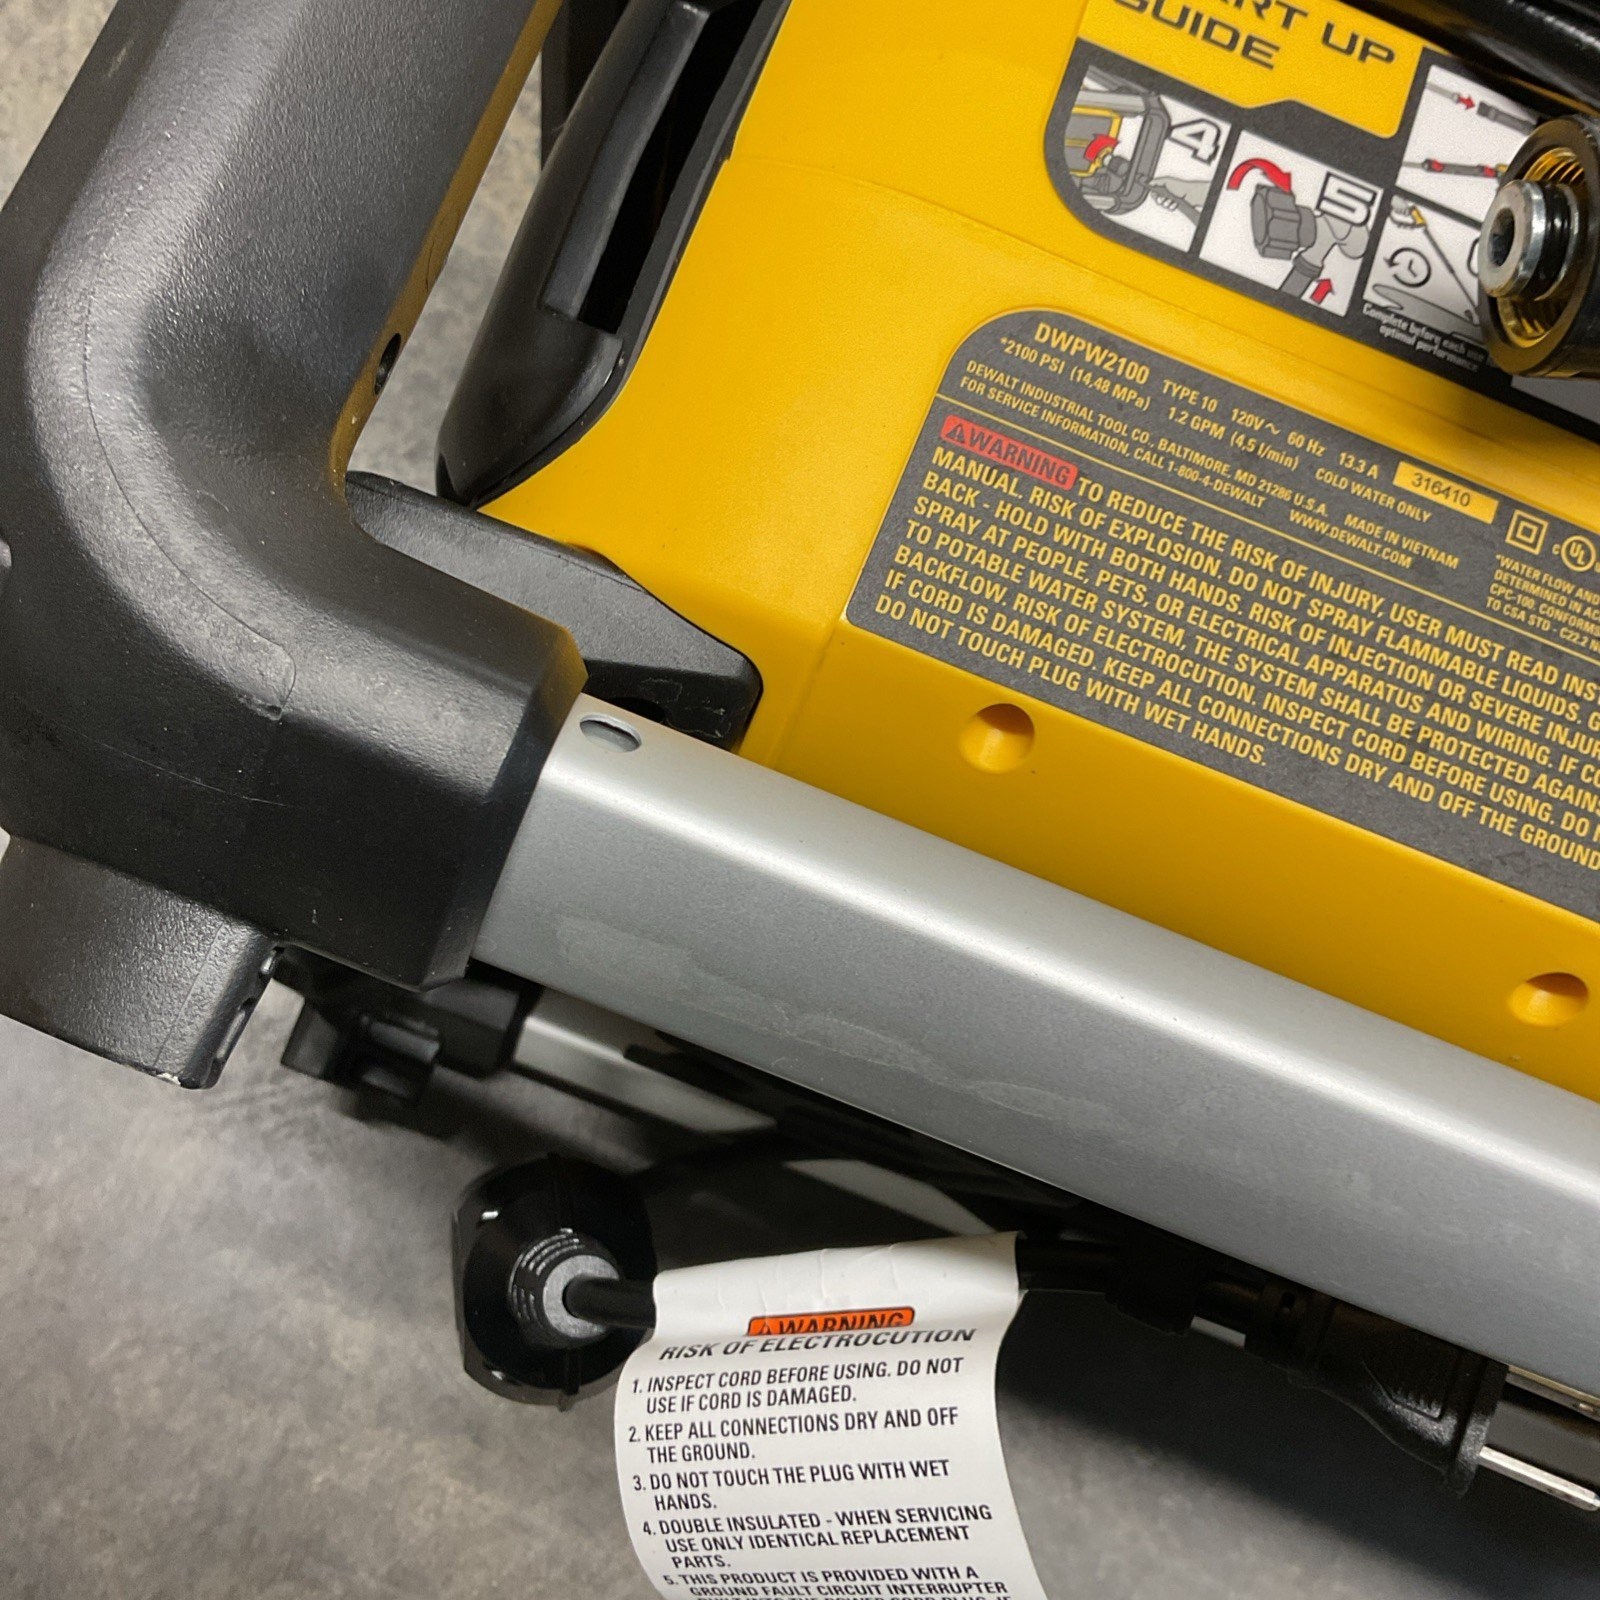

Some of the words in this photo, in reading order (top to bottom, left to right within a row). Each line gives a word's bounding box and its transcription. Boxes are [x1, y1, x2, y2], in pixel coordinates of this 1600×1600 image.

[1321, 21, 1396, 64] UP
[1168, 118, 1221, 166] 4
[1316, 172, 1377, 227] 5
[1034, 322, 1151, 385] DWPW2100
[1164, 379, 1199, 405] TYPE
[1202, 396, 1218, 413] 10
[1287, 431, 1307, 448] 60
[1306, 439, 1326, 457] Hz
[1340, 452, 1367, 473] 13.3
[1367, 464, 1380, 480] A
[1038, 353, 1067, 374] PSI
[1069, 367, 1113, 394] (14,48
[1111, 382, 1151, 410] MPa)
[1168, 406, 1190, 425] 1.2
[1190, 415, 1227, 439] GPM
[1229, 431, 1257, 453] (4,5
[1315, 467, 1350, 490] COLD
[1347, 481, 1397, 509] WATER
[1395, 500, 1432, 522] ONLY
[959, 375, 987, 395] FOR
[987, 386, 1040, 417] SERVICE
[1040, 409, 1130, 456] INFORMATION,
[1132, 446, 1165, 468] CALL
[1168, 460, 1266, 509] 1-800-4-DEWALT
[1289, 509, 1413, 568] WWW.DEWALT.COM
[966, 359, 1019, 390] DEWALT
[1019, 381, 1094, 423] INDUSTRIAL
[1097, 412, 1128, 437] TOOL
[1156, 437, 1231, 477] BALTIMORE,
[1234, 468, 1259, 487] MD
[1292, 492, 1328, 517] U.S.A.
[1344, 513, 1385, 539] MADE
[1385, 530, 1402, 546] IN
[1401, 537, 1461, 569] VIETNAM
[1412, 472, 1471, 507] 316410
[968, 428, 1072, 487] WARNING
[1078, 476, 1105, 503] TO
[1106, 489, 1187, 535] REDUCE
[1191, 521, 1228, 552] THE
[1231, 538, 1279, 572] RISK
[1279, 559, 1308, 582] OF
[1308, 570, 1384, 617] INJURY,
[1389, 602, 1444, 638] USER
[1444, 624, 1506, 662] MUST
[1505, 649, 1560, 685] READ
[932, 445, 1022, 498] MANUAL.
[1029, 485, 1077, 520] RISK
[1079, 507, 1107, 530] OF
[1108, 518, 1222, 579] EXPLOSION.
[1228, 565, 1259, 592] DO
[1260, 578, 1308, 609] NOT
[1307, 597, 1375, 637] SPRAY
[1375, 624, 1500, 690] FLAMMABLE
[1500, 675, 1581, 722] LIQUIDS.
[1494, 569, 1568, 608] DETERMINED
[1568, 601, 1582, 613] IN
[1541, 573, 1575, 594] FLOW
[875, 593, 907, 621] DO
[908, 606, 955, 639] NOT
[957, 625, 1027, 670] TOUCH
[1027, 655, 1083, 692] PLUG
[1085, 676, 1142, 715] WITH
[1143, 699, 1191, 733] WET
[1191, 720, 1266, 765] HANDS.
[885, 568, 906, 590] IF
[908, 578, 964, 614] CORD
[966, 602, 989, 625] IS
[991, 612, 1096, 667] DAMAGED.
[1102, 656, 1156, 688] KEEP
[1156, 679, 1192, 708] ALL
[1197, 694, 1343, 766] CONNECTIONS
[1344, 752, 1388, 782] DRY
[1388, 771, 1436, 803] AND
[1438, 790, 1476, 817] OFF
[1479, 805, 1517, 836] THE
[778, 1311, 906, 1335] WARNING
[658, 1342, 720, 1361] RISK
[722, 1339, 759, 1356] OF
[758, 1328, 977, 1353] ELECTROCUTION
[633, 1378, 643, 1394] 1.
[647, 1372, 716, 1393] INSPECT
[718, 1369, 762, 1388] CORD
[766, 1364, 830, 1385] BEFORE
[833, 1361, 891, 1381] USING.
[896, 1359, 922, 1377] DO
[926, 1356, 965, 1375] NOT
[646, 1395, 677, 1415] USE
[681, 1394, 695, 1412] IF
[698, 1391, 742, 1411] CORD
[746, 1390, 762, 1408] IS
[766, 1384, 857, 1407] DAMAGED.
[628, 1425, 641, 1443] 2.
[645, 1422, 683, 1442] KEEP
[687, 1420, 717, 1440] ALL
[720, 1413, 840, 1438] CONNECTIONS
[844, 1410, 879, 1431] DRY
[883, 1408, 922, 1429] AND
[927, 1406, 959, 1427] OFF
[646, 1445, 678, 1464] THE
[681, 1441, 756, 1462] GROUND.
[632, 1474, 647, 1492] 3.
[649, 1472, 672, 1491] DO
[676, 1470, 709, 1489] NOT
[712, 1467, 770, 1488] TOUCH
[772, 1465, 807, 1485] THE
[809, 1463, 855, 1483] PLUG
[856, 1460, 907, 1481] WITH
[908, 1459, 950, 1478] WET
[642, 1520, 657, 1536] 4.
[658, 1517, 725, 1535] DOUBLE
[725, 1512, 821, 1532] INSULATED
[833, 1508, 892, 1527] WHEN
[894, 1504, 993, 1524] SERVICING
[654, 1492, 718, 1512] HANDS.
[664, 1537, 700, 1554] USE
[700, 1535, 744, 1552] ONLY
[748, 1531, 840, 1550] IDENTICAL
[840, 1524, 970, 1546] REPLACEMENT
[662, 1575, 679, 1585] 5.
[677, 1573, 718, 1585] THIS
[719, 1571, 797, 1585] PRODUCT
[800, 1570, 820, 1583] IS
[821, 1567, 909, 1583] PROVIDED
[910, 1566, 962, 1581] WITH
[966, 1565, 980, 1579] A
[671, 1554, 731, 1569] PARTS.
[689, 1586, 759, 1597] GROUND
[760, 1585, 812, 1596] FAULT
[816, 1583, 882, 1596] CIRCUIT
[885, 1581, 1009, 1596] INTERRUPTER
